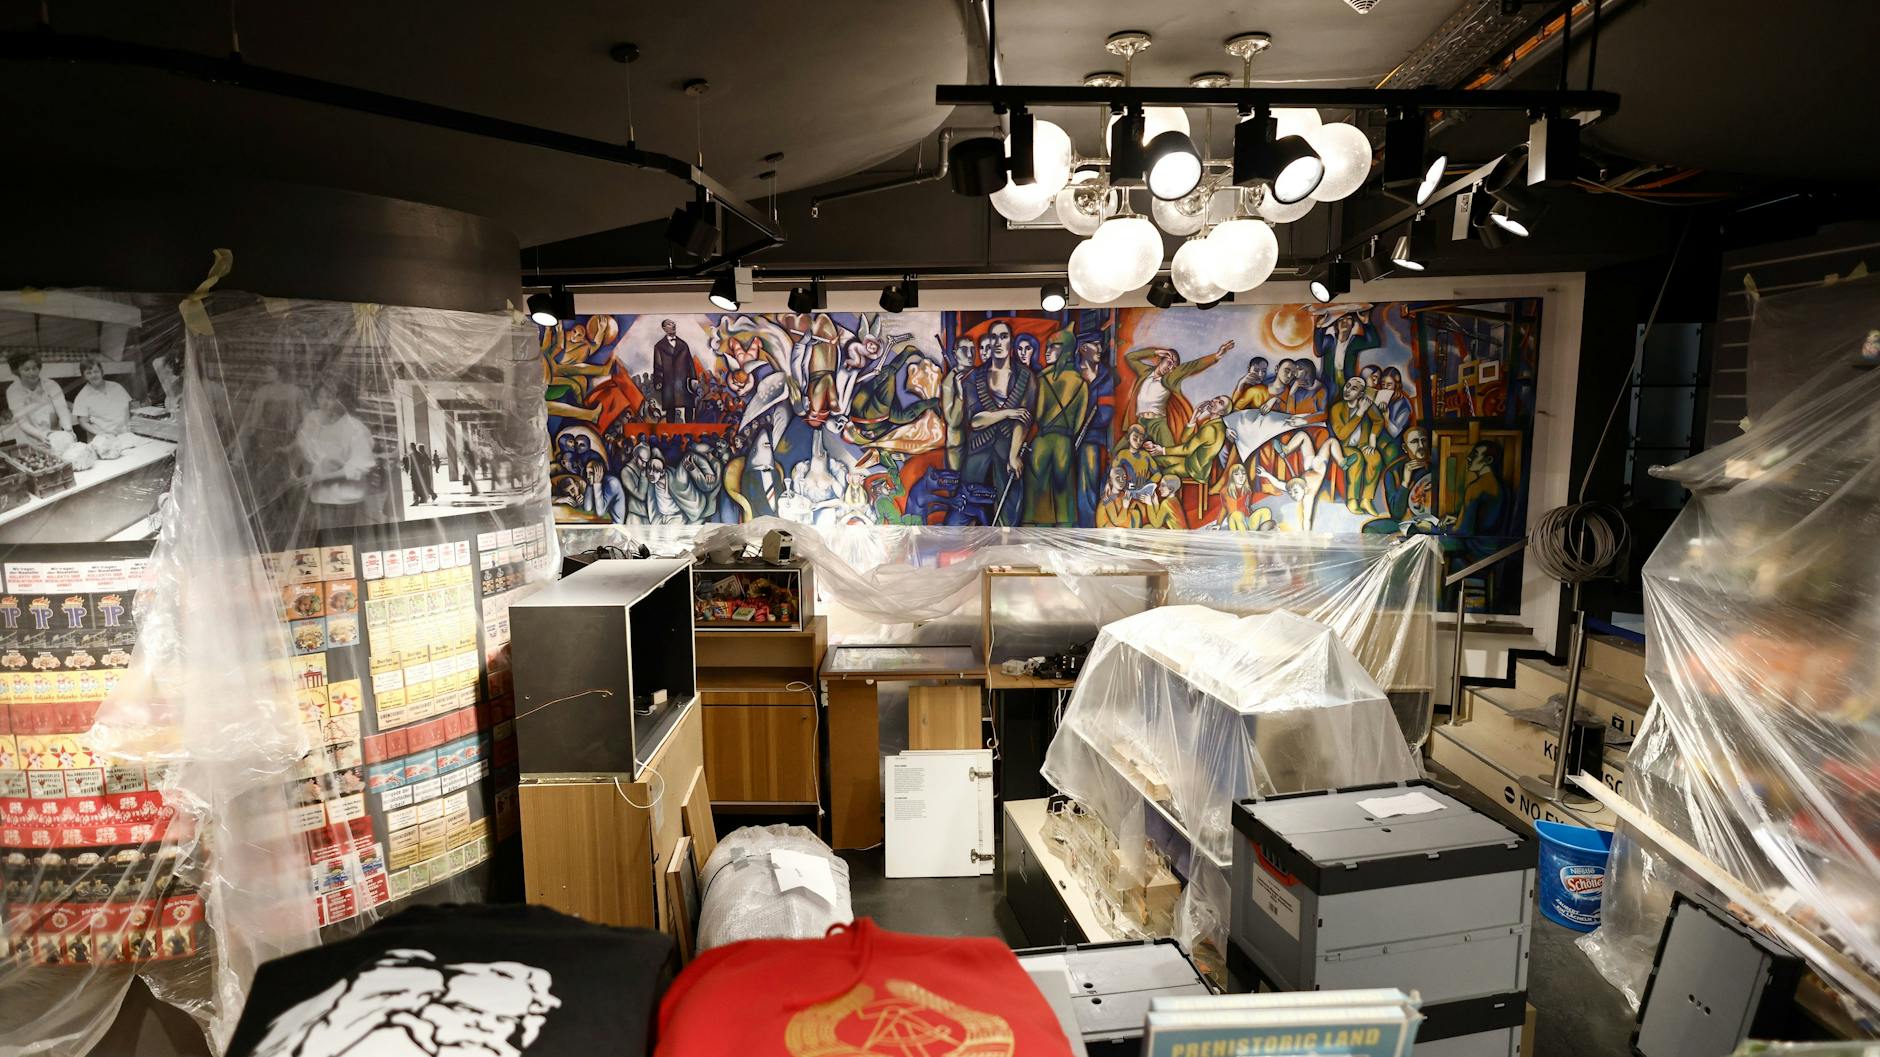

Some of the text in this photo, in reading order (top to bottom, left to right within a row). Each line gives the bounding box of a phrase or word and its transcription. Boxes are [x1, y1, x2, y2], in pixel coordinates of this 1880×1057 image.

[1519, 794, 1541, 820] NO
[1171, 1027, 1382, 1057] PREHISTORIC LAND
